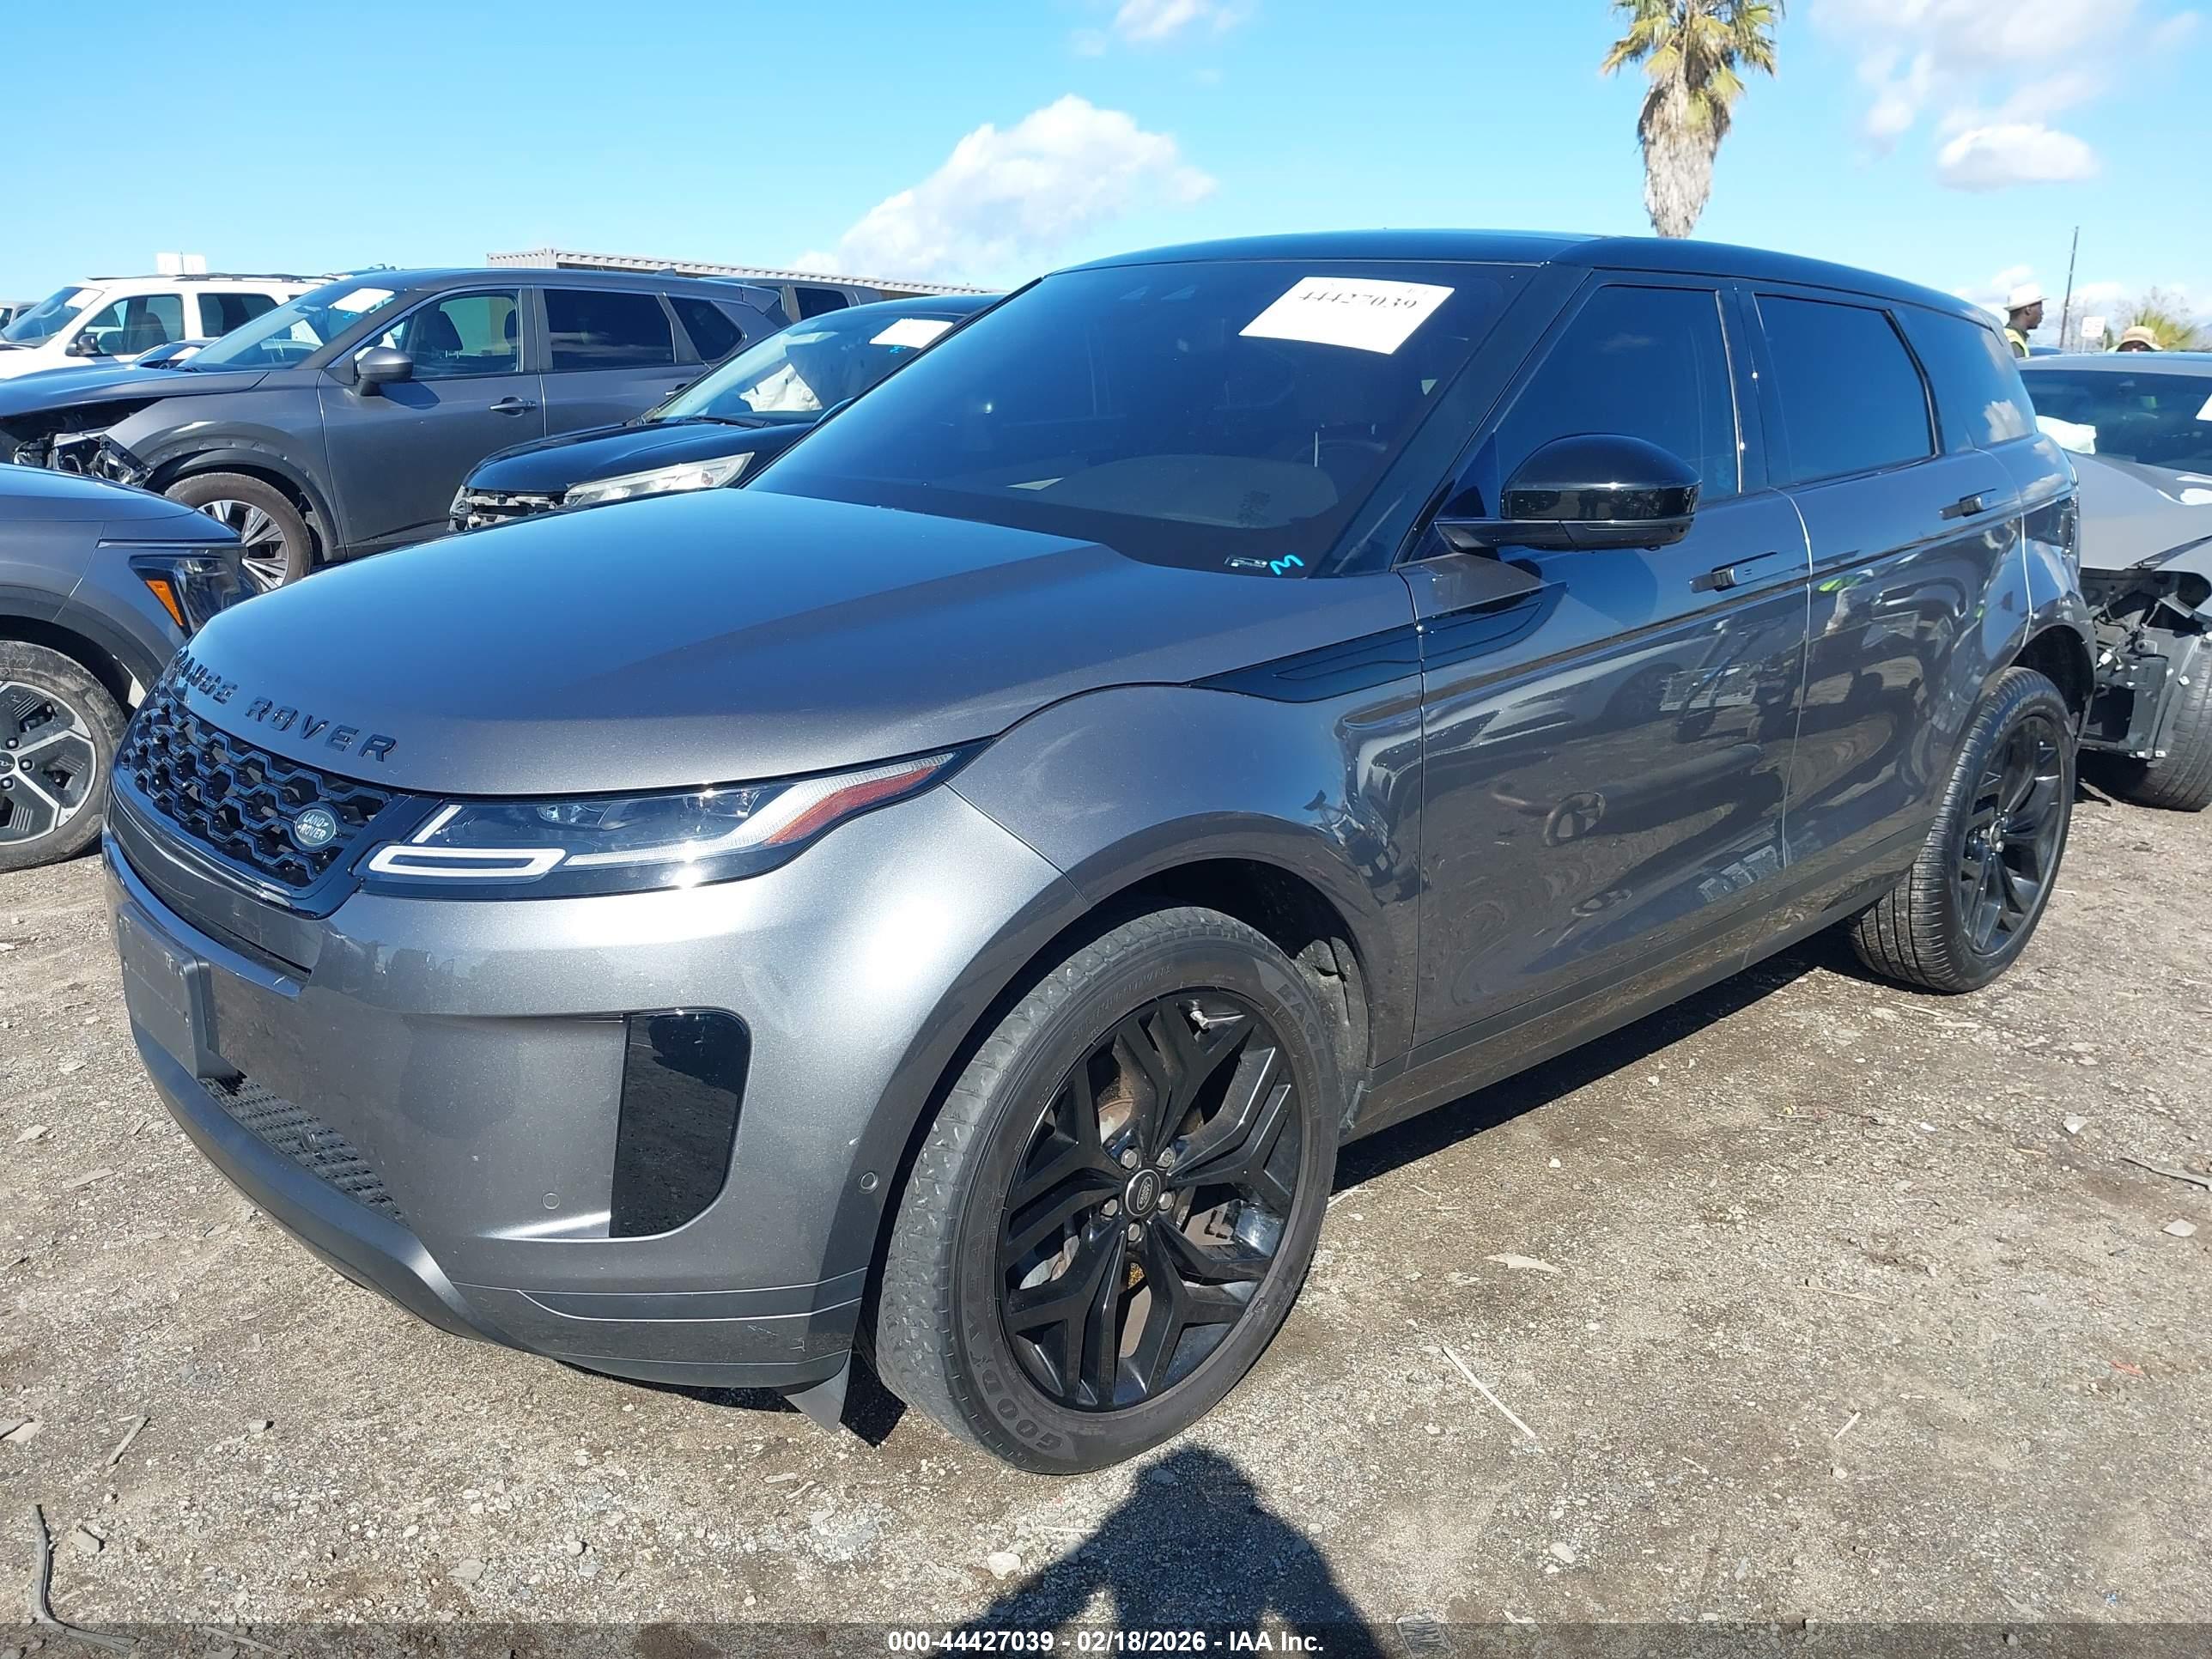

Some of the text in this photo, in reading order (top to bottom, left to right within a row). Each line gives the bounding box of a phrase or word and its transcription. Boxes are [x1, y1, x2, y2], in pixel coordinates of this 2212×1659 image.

[1298, 291, 1418, 308] 44427039
[245, 696, 398, 763] ROVER
[303, 812, 325, 827] LAND
[300, 823, 326, 840] ROVER
